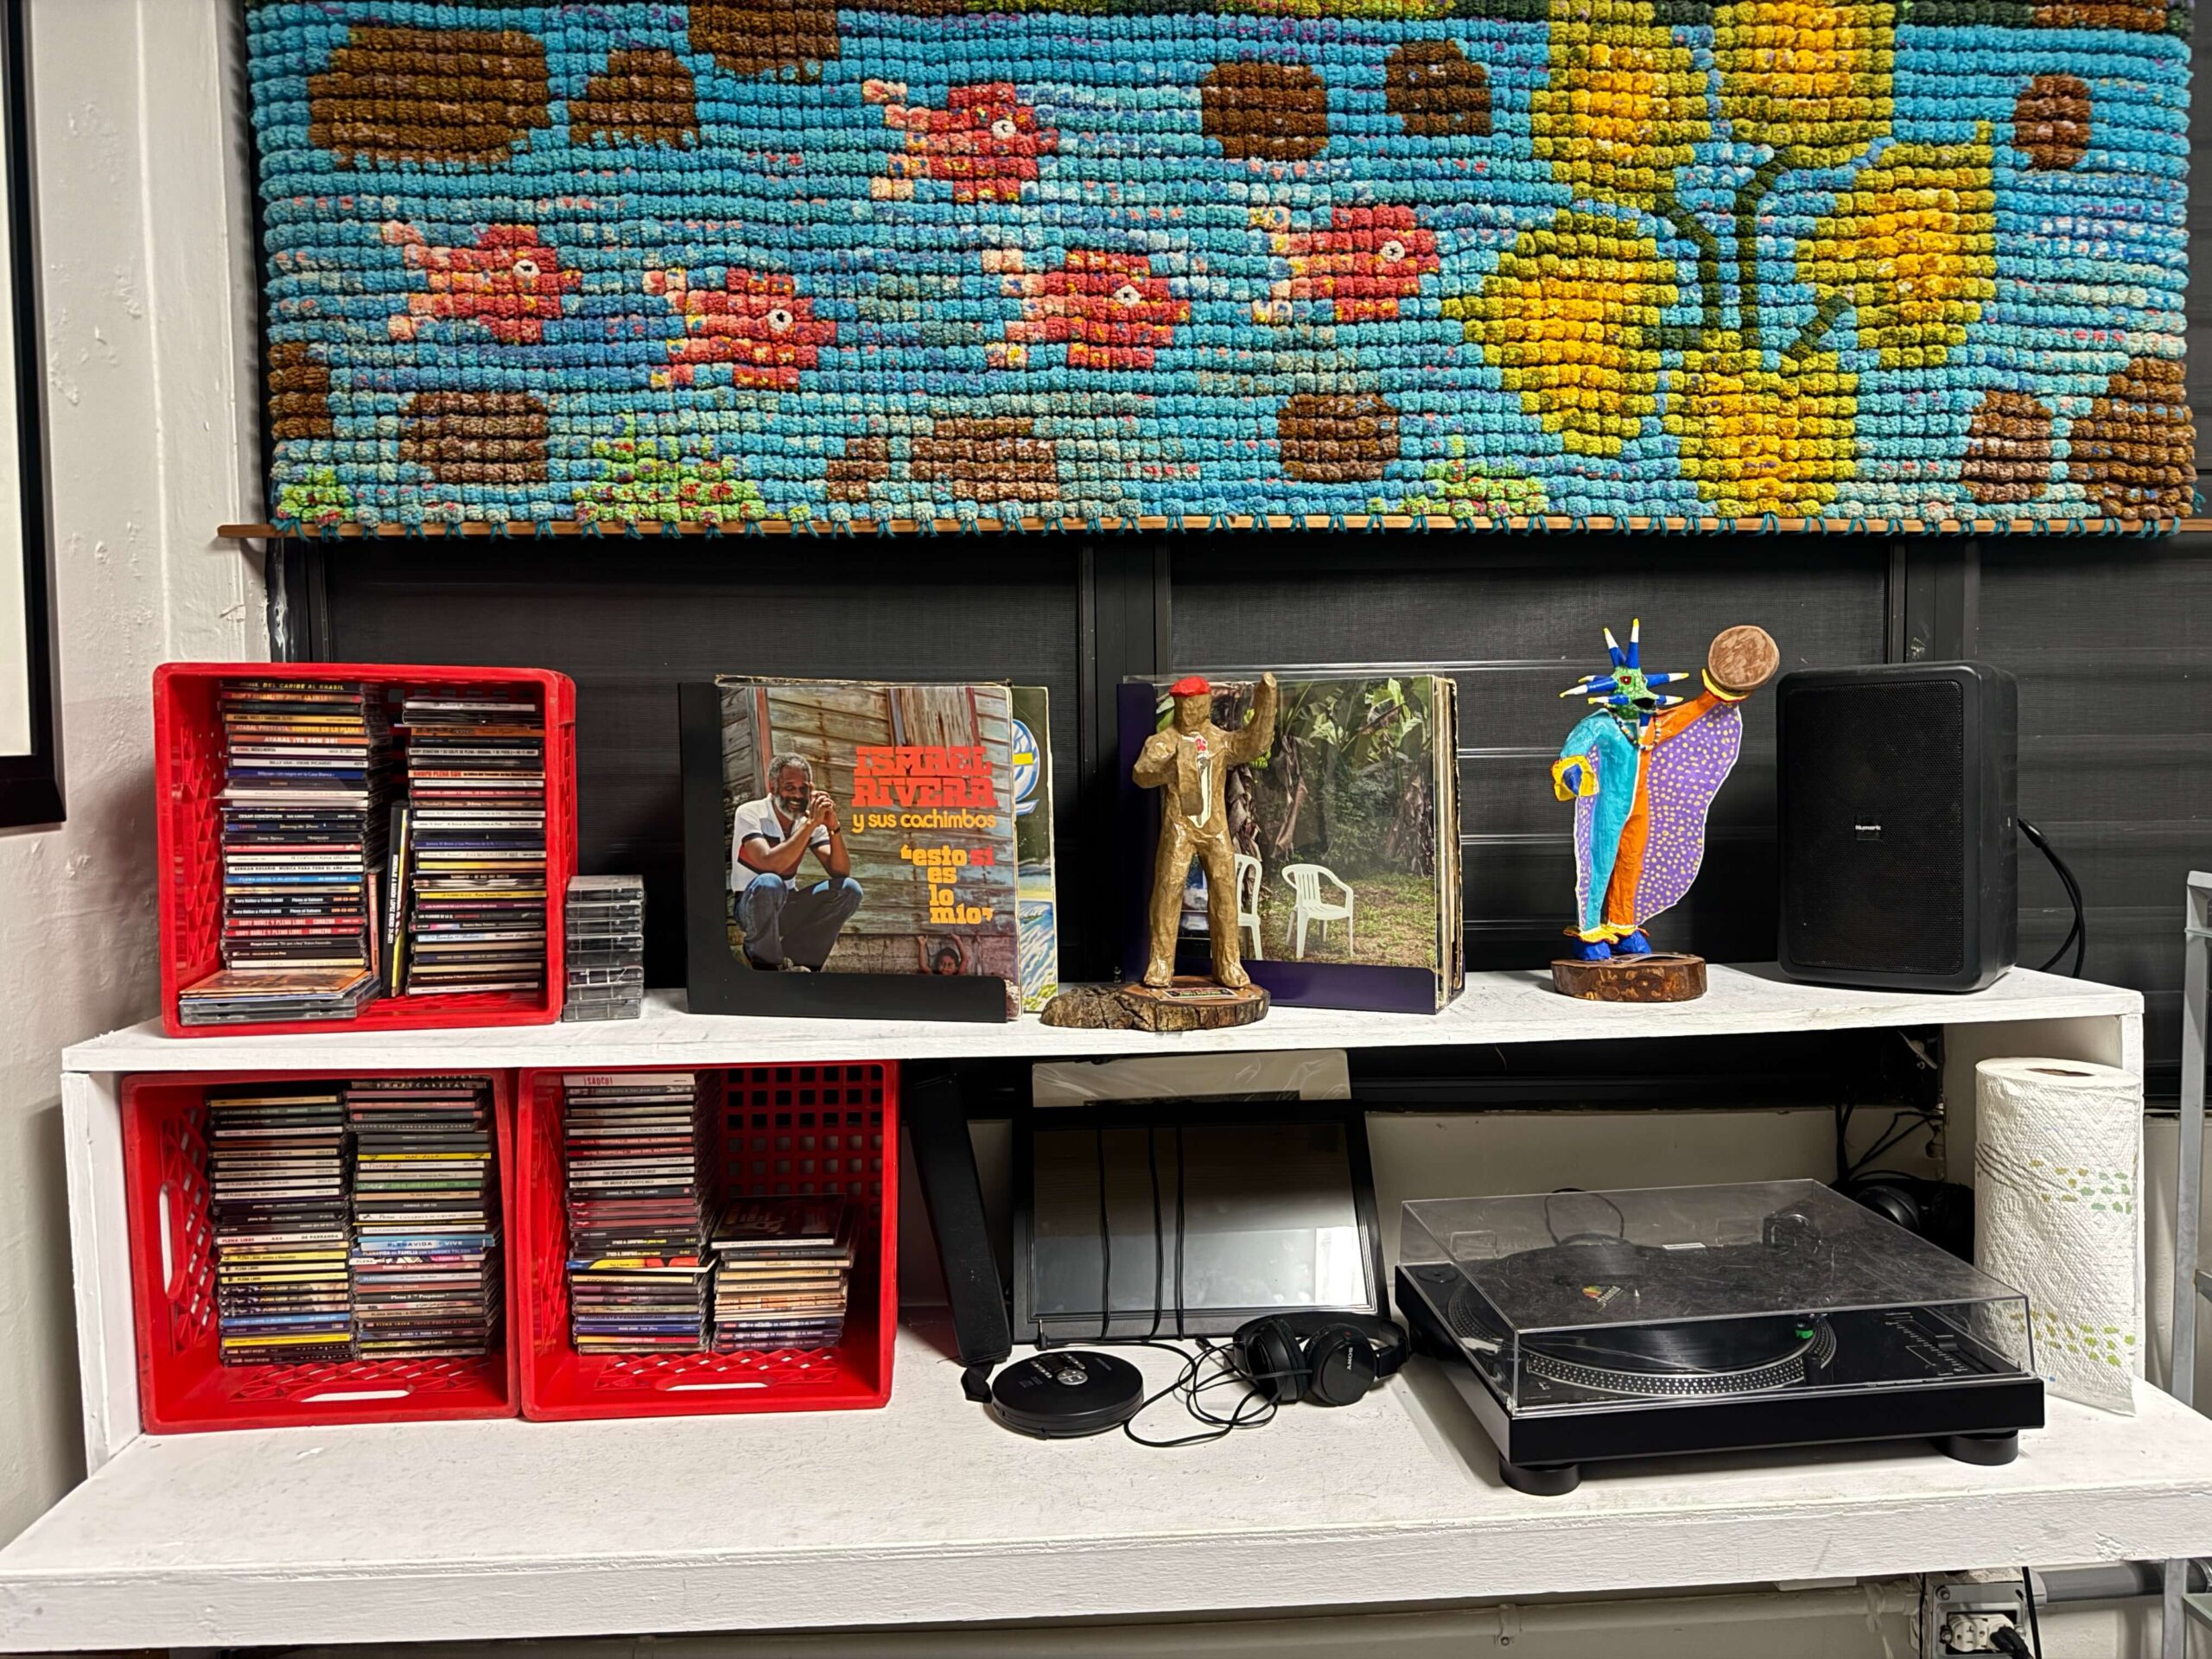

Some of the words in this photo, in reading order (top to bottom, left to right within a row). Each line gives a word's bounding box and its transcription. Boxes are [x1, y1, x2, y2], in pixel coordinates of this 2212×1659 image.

[854, 747, 993, 776] ISMAEL
[852, 778, 998, 807] RIVERA
[852, 814, 864, 833] y
[868, 813, 897, 828] sus
[900, 809, 996, 829] cachimbos
[927, 867, 957, 884] es
[928, 884, 955, 906] lo
